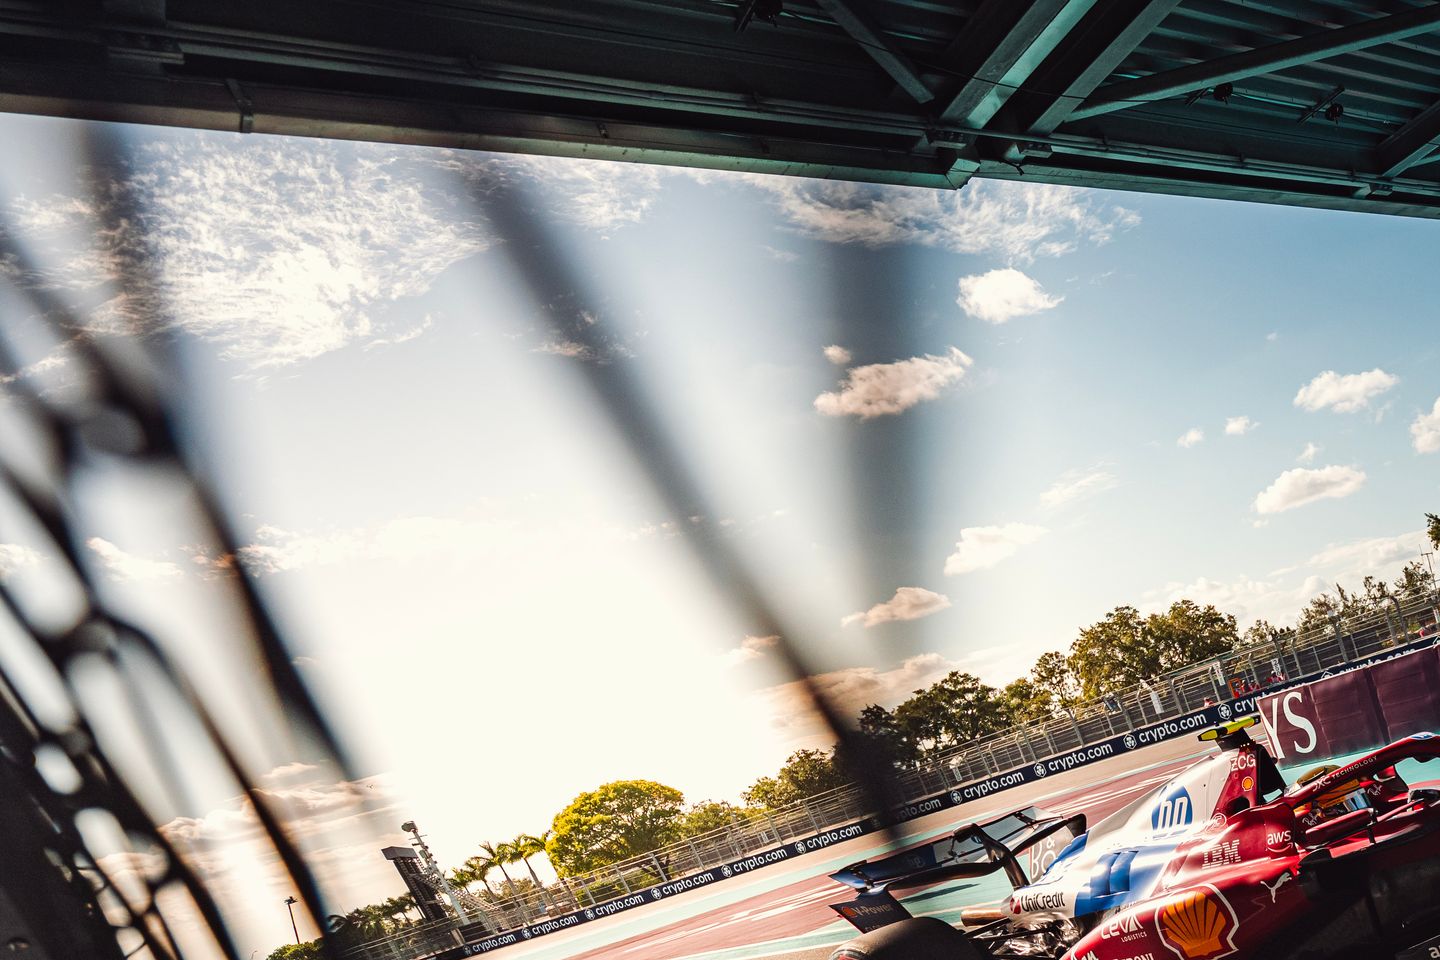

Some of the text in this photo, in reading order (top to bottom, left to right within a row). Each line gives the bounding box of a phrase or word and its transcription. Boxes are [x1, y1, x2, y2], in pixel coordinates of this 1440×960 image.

[1138, 710, 1207, 744] crypto.com
[1048, 741, 1113, 772] crypto.com
[1331, 755, 1378, 780] TECHNOLOGY
[963, 770, 1024, 799] crypto.com
[899, 797, 941, 821] pto.com
[806, 824, 863, 849] crypto.com
[1266, 830, 1292, 846] aws
[733, 847, 788, 874] crypto.com
[1201, 839, 1243, 870] IBM
[662, 871, 715, 896] crypto.com
[595, 894, 645, 917] crypto.com
[1020, 890, 1067, 913] UniCredit
[532, 914, 579, 936] crypto.com
[472, 932, 516, 953] crypto.com
